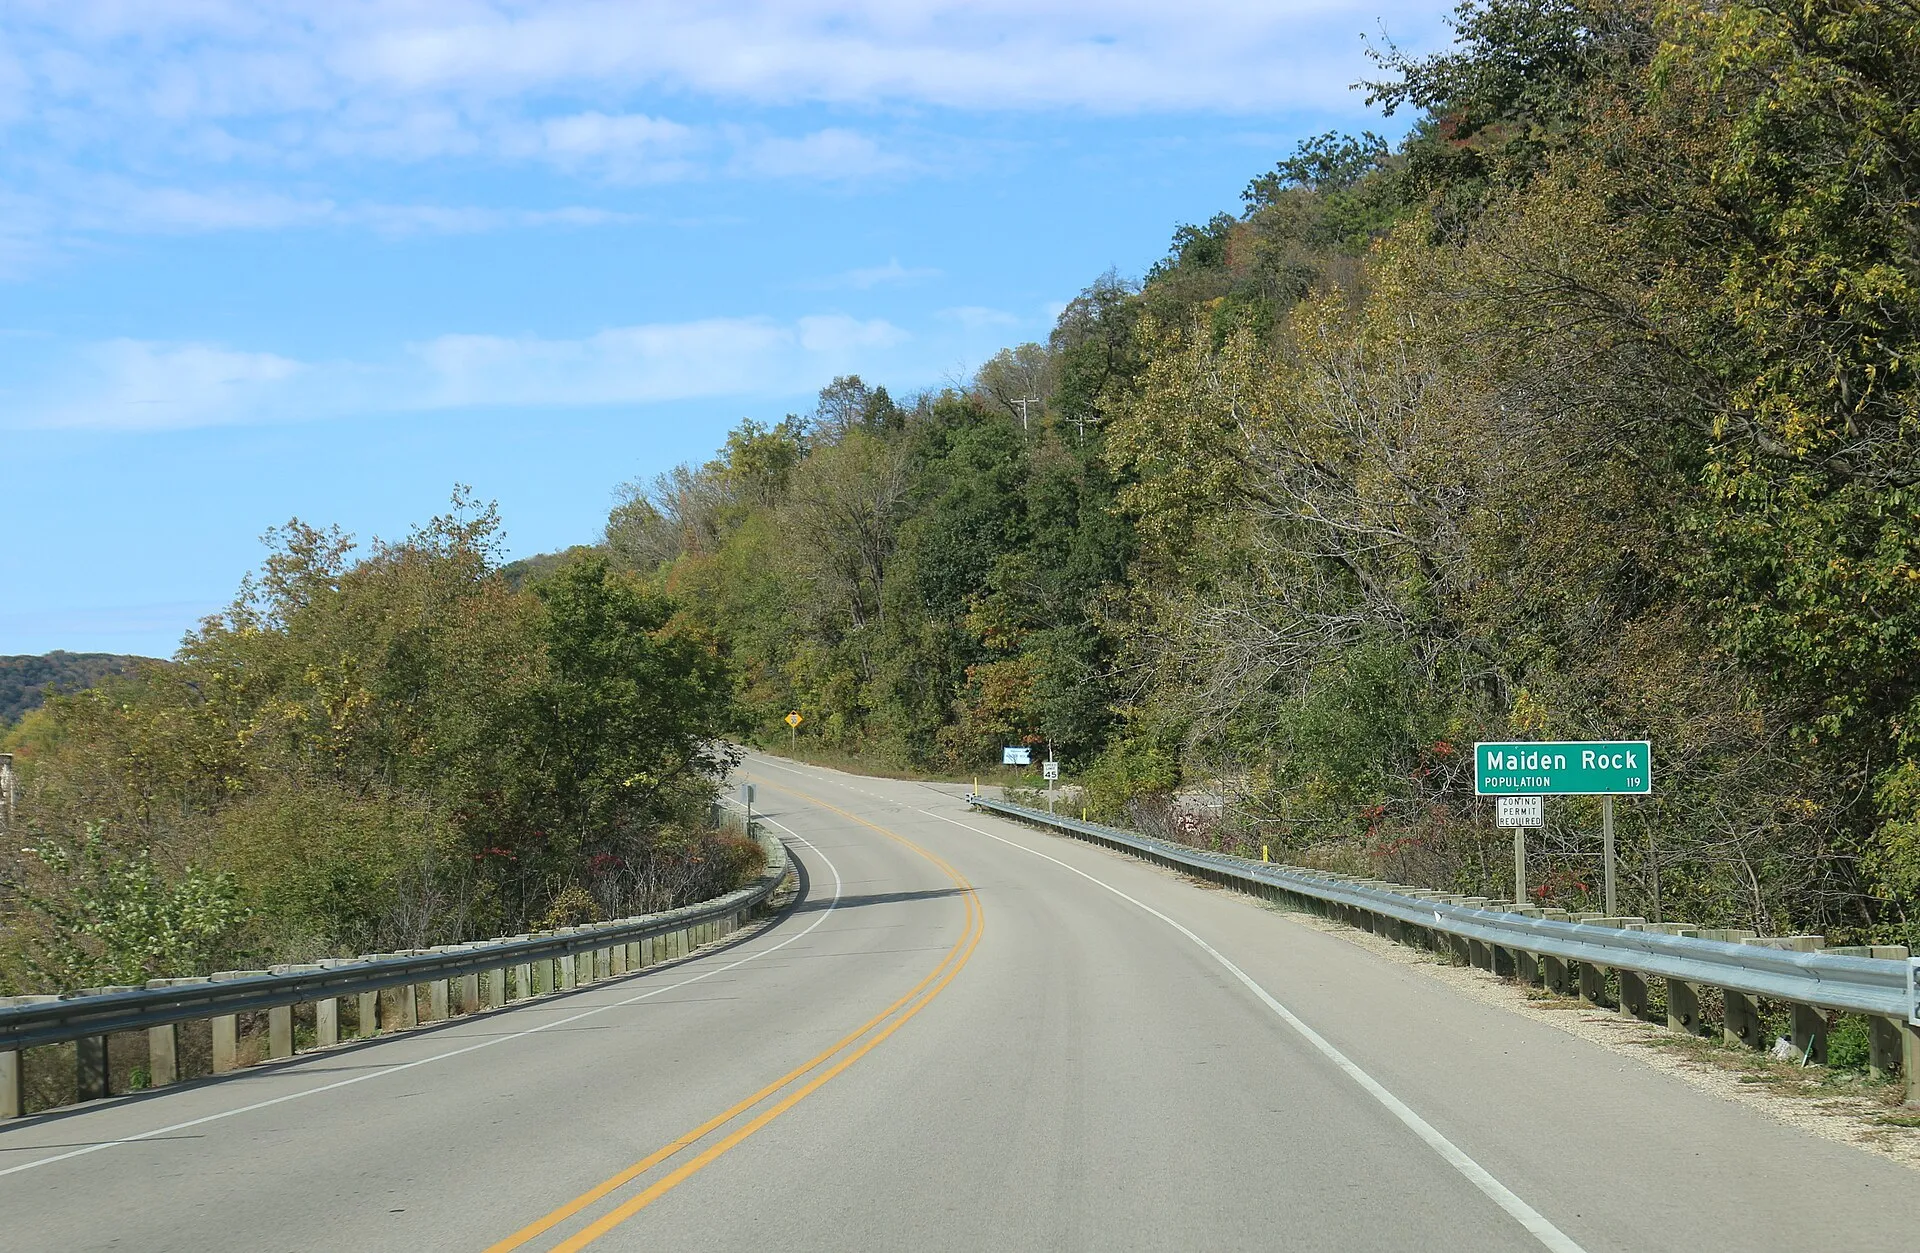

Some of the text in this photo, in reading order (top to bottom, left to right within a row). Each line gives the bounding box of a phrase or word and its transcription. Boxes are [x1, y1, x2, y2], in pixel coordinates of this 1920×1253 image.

[1487, 750, 1638, 770] Maiden Rock
[1485, 777, 1641, 787] POPULATION 119
